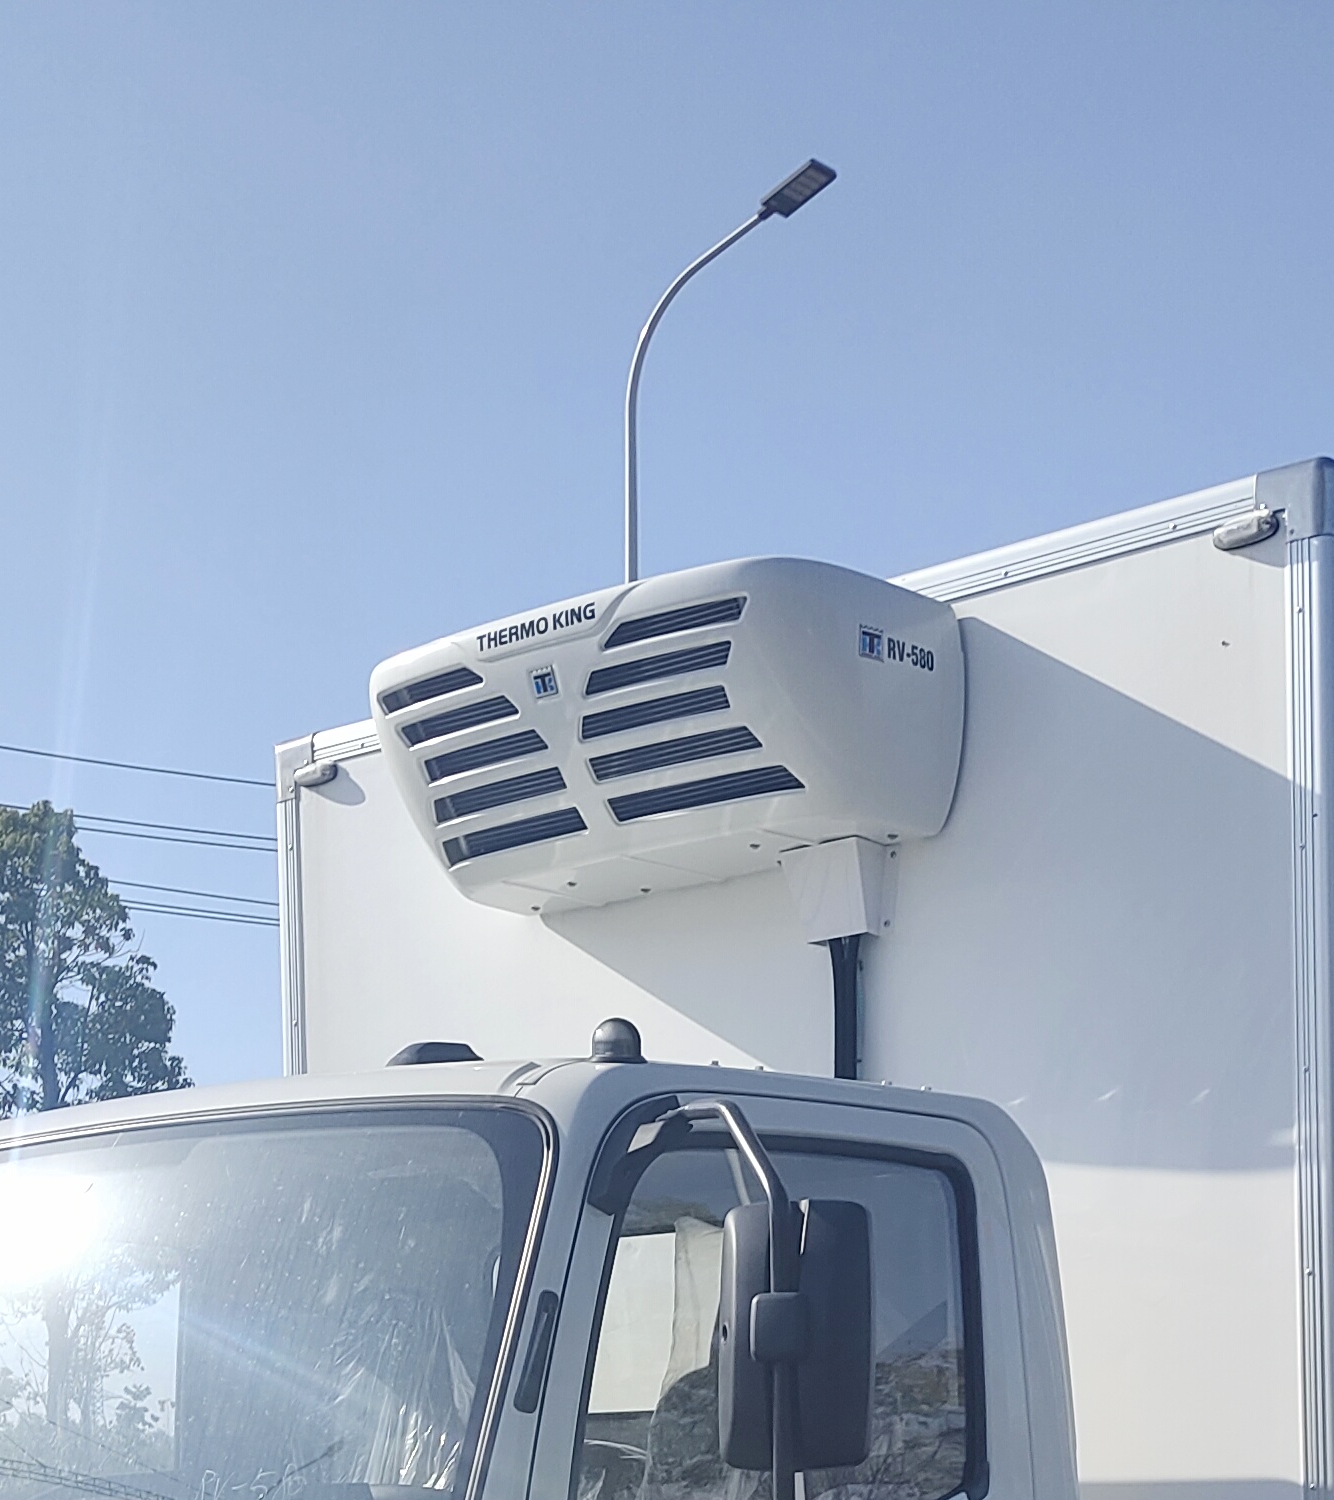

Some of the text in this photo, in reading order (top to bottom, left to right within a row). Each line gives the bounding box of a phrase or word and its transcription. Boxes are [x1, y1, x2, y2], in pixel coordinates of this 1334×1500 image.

[476, 602, 596, 652] THERMO KING
[887, 637, 935, 672] RV-580
